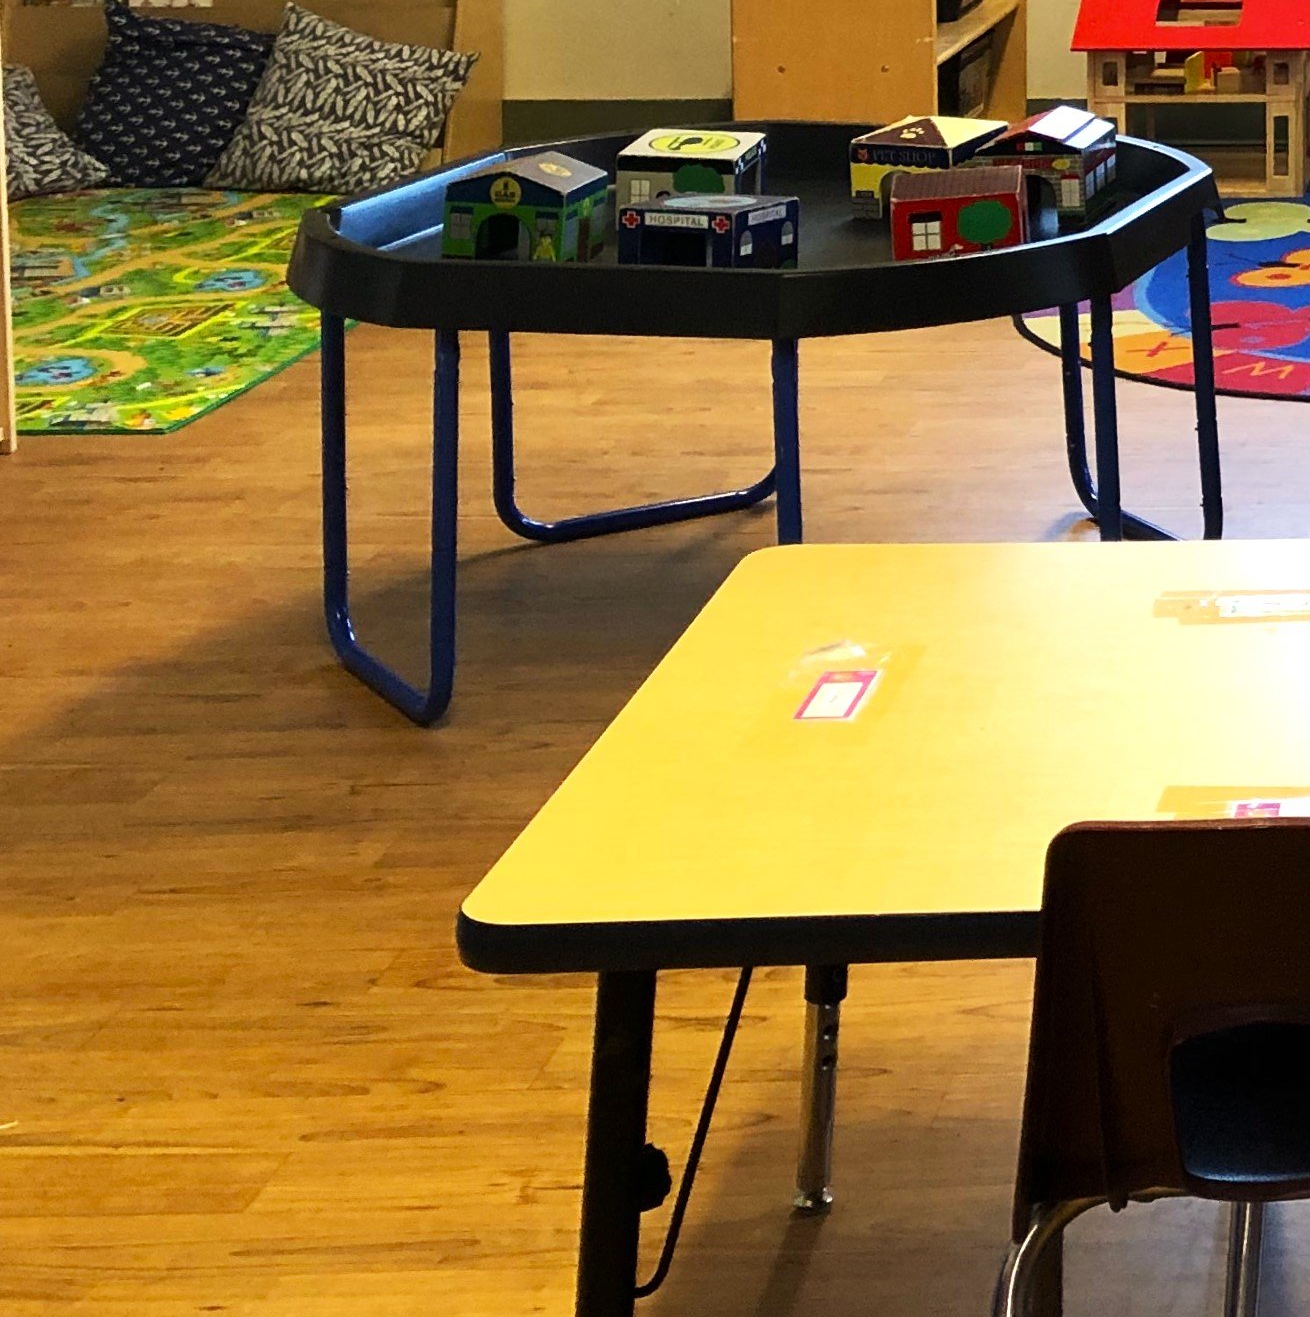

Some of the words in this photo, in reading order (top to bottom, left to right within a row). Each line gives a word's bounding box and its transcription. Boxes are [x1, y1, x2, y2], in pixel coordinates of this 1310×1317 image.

[873, 149, 895, 162] PET
[899, 150, 937, 163] SHOP
[650, 213, 704, 226] HOSPITAL
